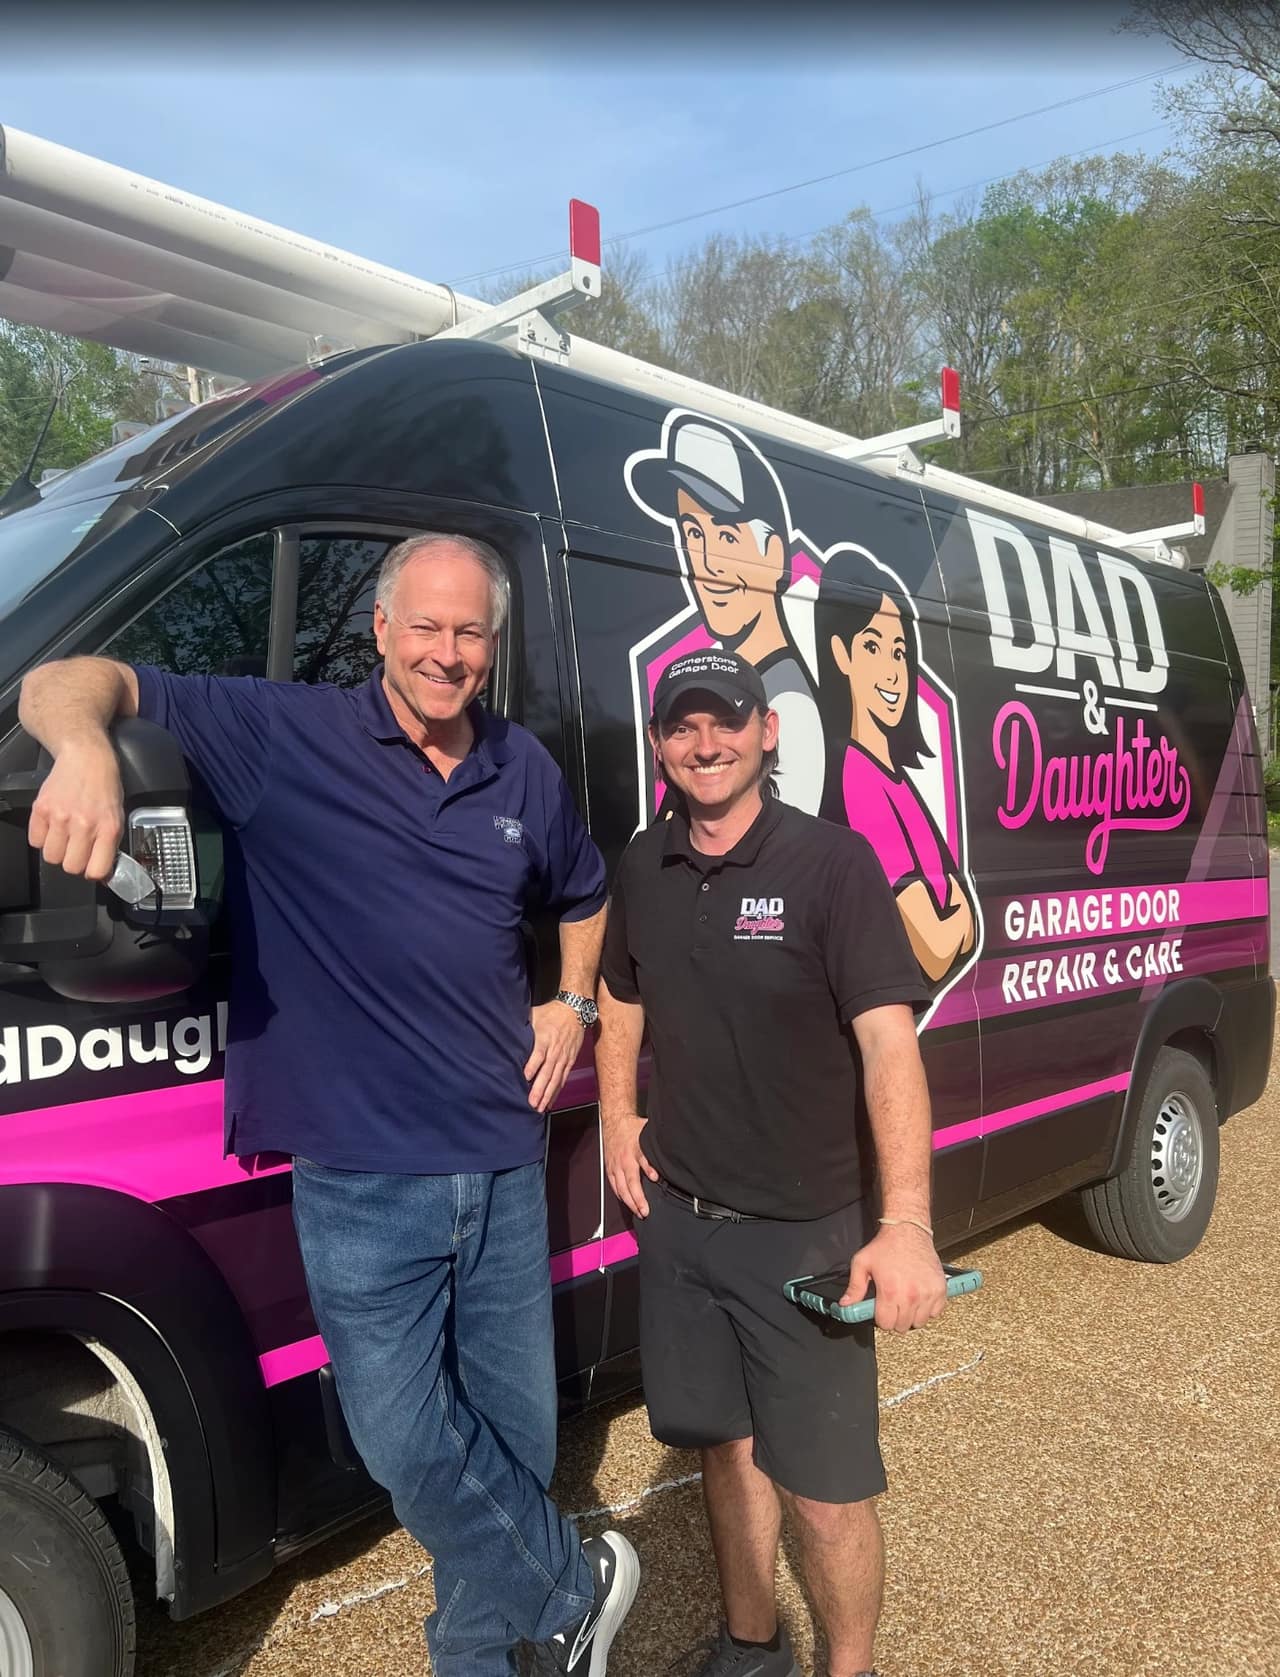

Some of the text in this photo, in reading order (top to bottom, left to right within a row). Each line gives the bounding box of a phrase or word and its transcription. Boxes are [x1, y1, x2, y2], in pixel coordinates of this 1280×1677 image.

[965, 508, 1170, 694] DAD
[711, 662, 740, 674] Door
[1083, 679, 1109, 735] &
[992, 700, 1191, 875] Daughter
[740, 897, 784, 915] DAD
[1004, 888, 1181, 941] GARAGE DOOR
[1001, 938, 1184, 1004] REPAIR & CARE
[0, 1001, 229, 1085] dDaug
